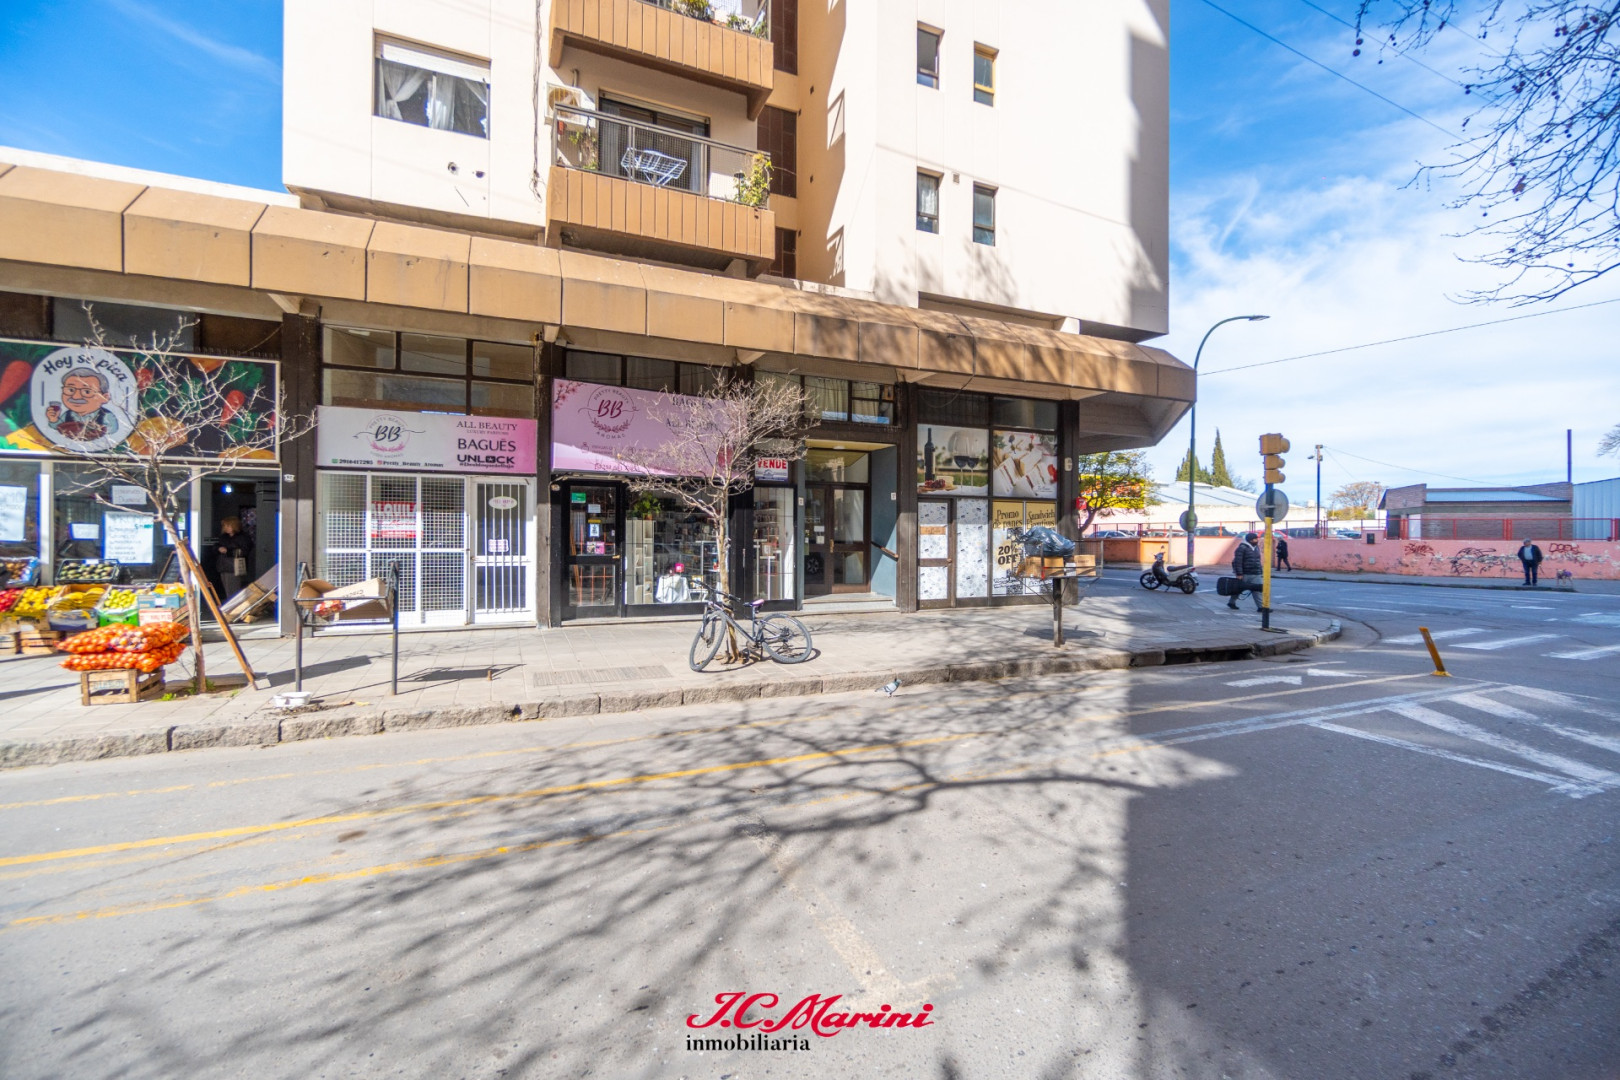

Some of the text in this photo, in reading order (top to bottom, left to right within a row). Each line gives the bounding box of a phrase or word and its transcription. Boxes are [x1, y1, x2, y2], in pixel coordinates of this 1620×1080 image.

[43, 355, 73, 376] Hoy
[95, 359, 128, 382] pica
[597, 399, 624, 419] BB
[456, 420, 518, 431] ALL BEAUTY
[375, 425, 401, 442] BB
[757, 458, 787, 470] VENDE
[997, 510, 1020, 520] Promo
[1028, 509, 1056, 520] Sandwich
[1003, 520, 1023, 531] panes
[997, 555, 1018, 566] OFF
